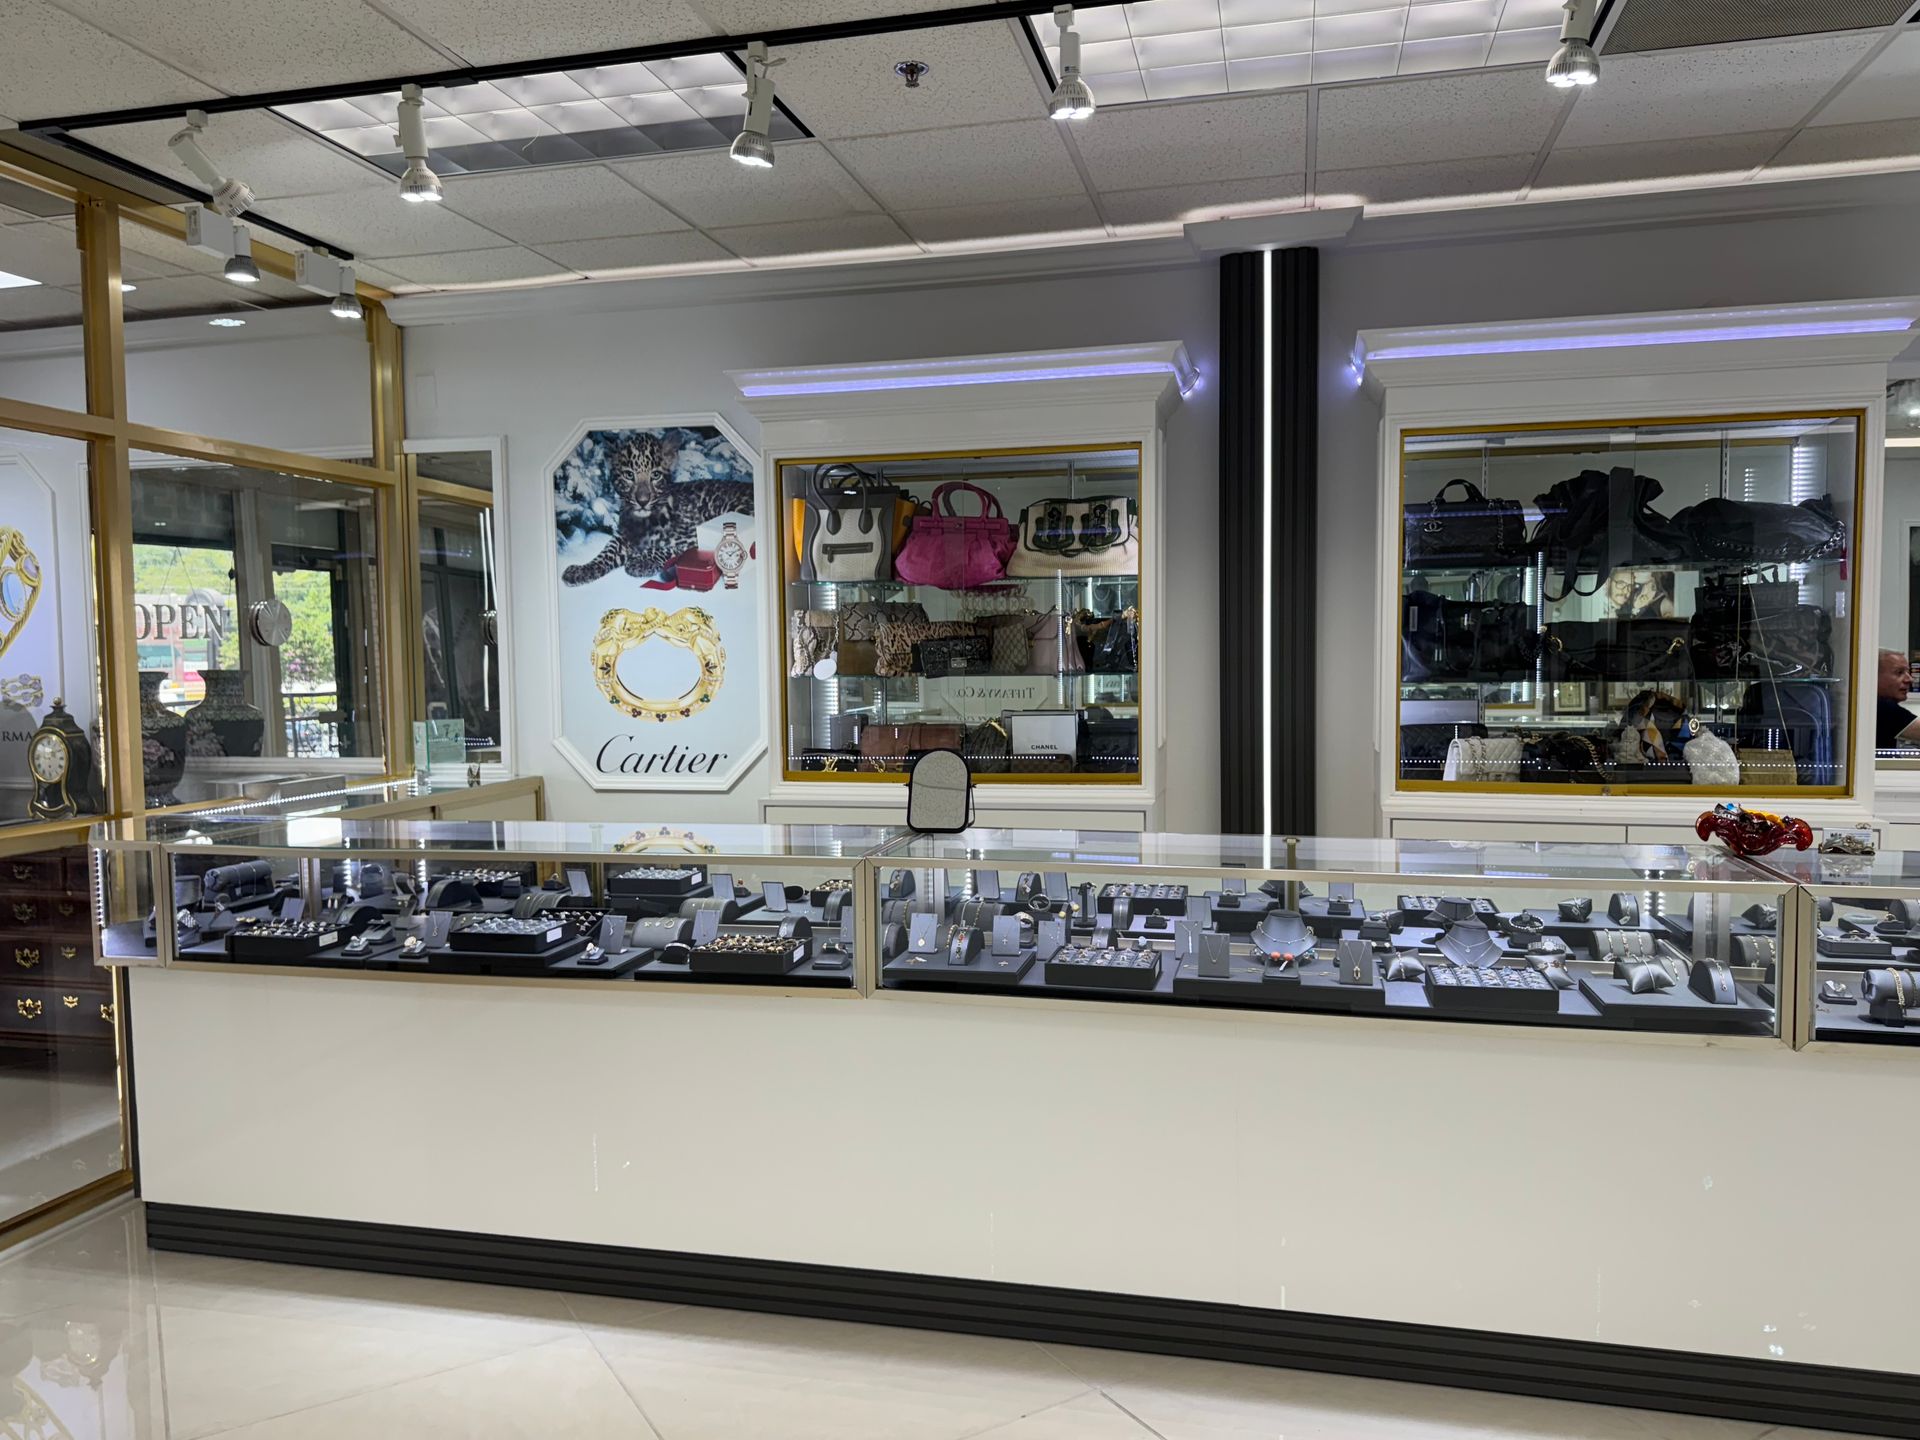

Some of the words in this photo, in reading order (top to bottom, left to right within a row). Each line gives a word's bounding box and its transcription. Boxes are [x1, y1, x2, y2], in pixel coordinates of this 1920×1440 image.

[134, 604, 225, 640] OPEN
[595, 733, 728, 774] Cartier
[1030, 743, 1059, 751] CHANEL
